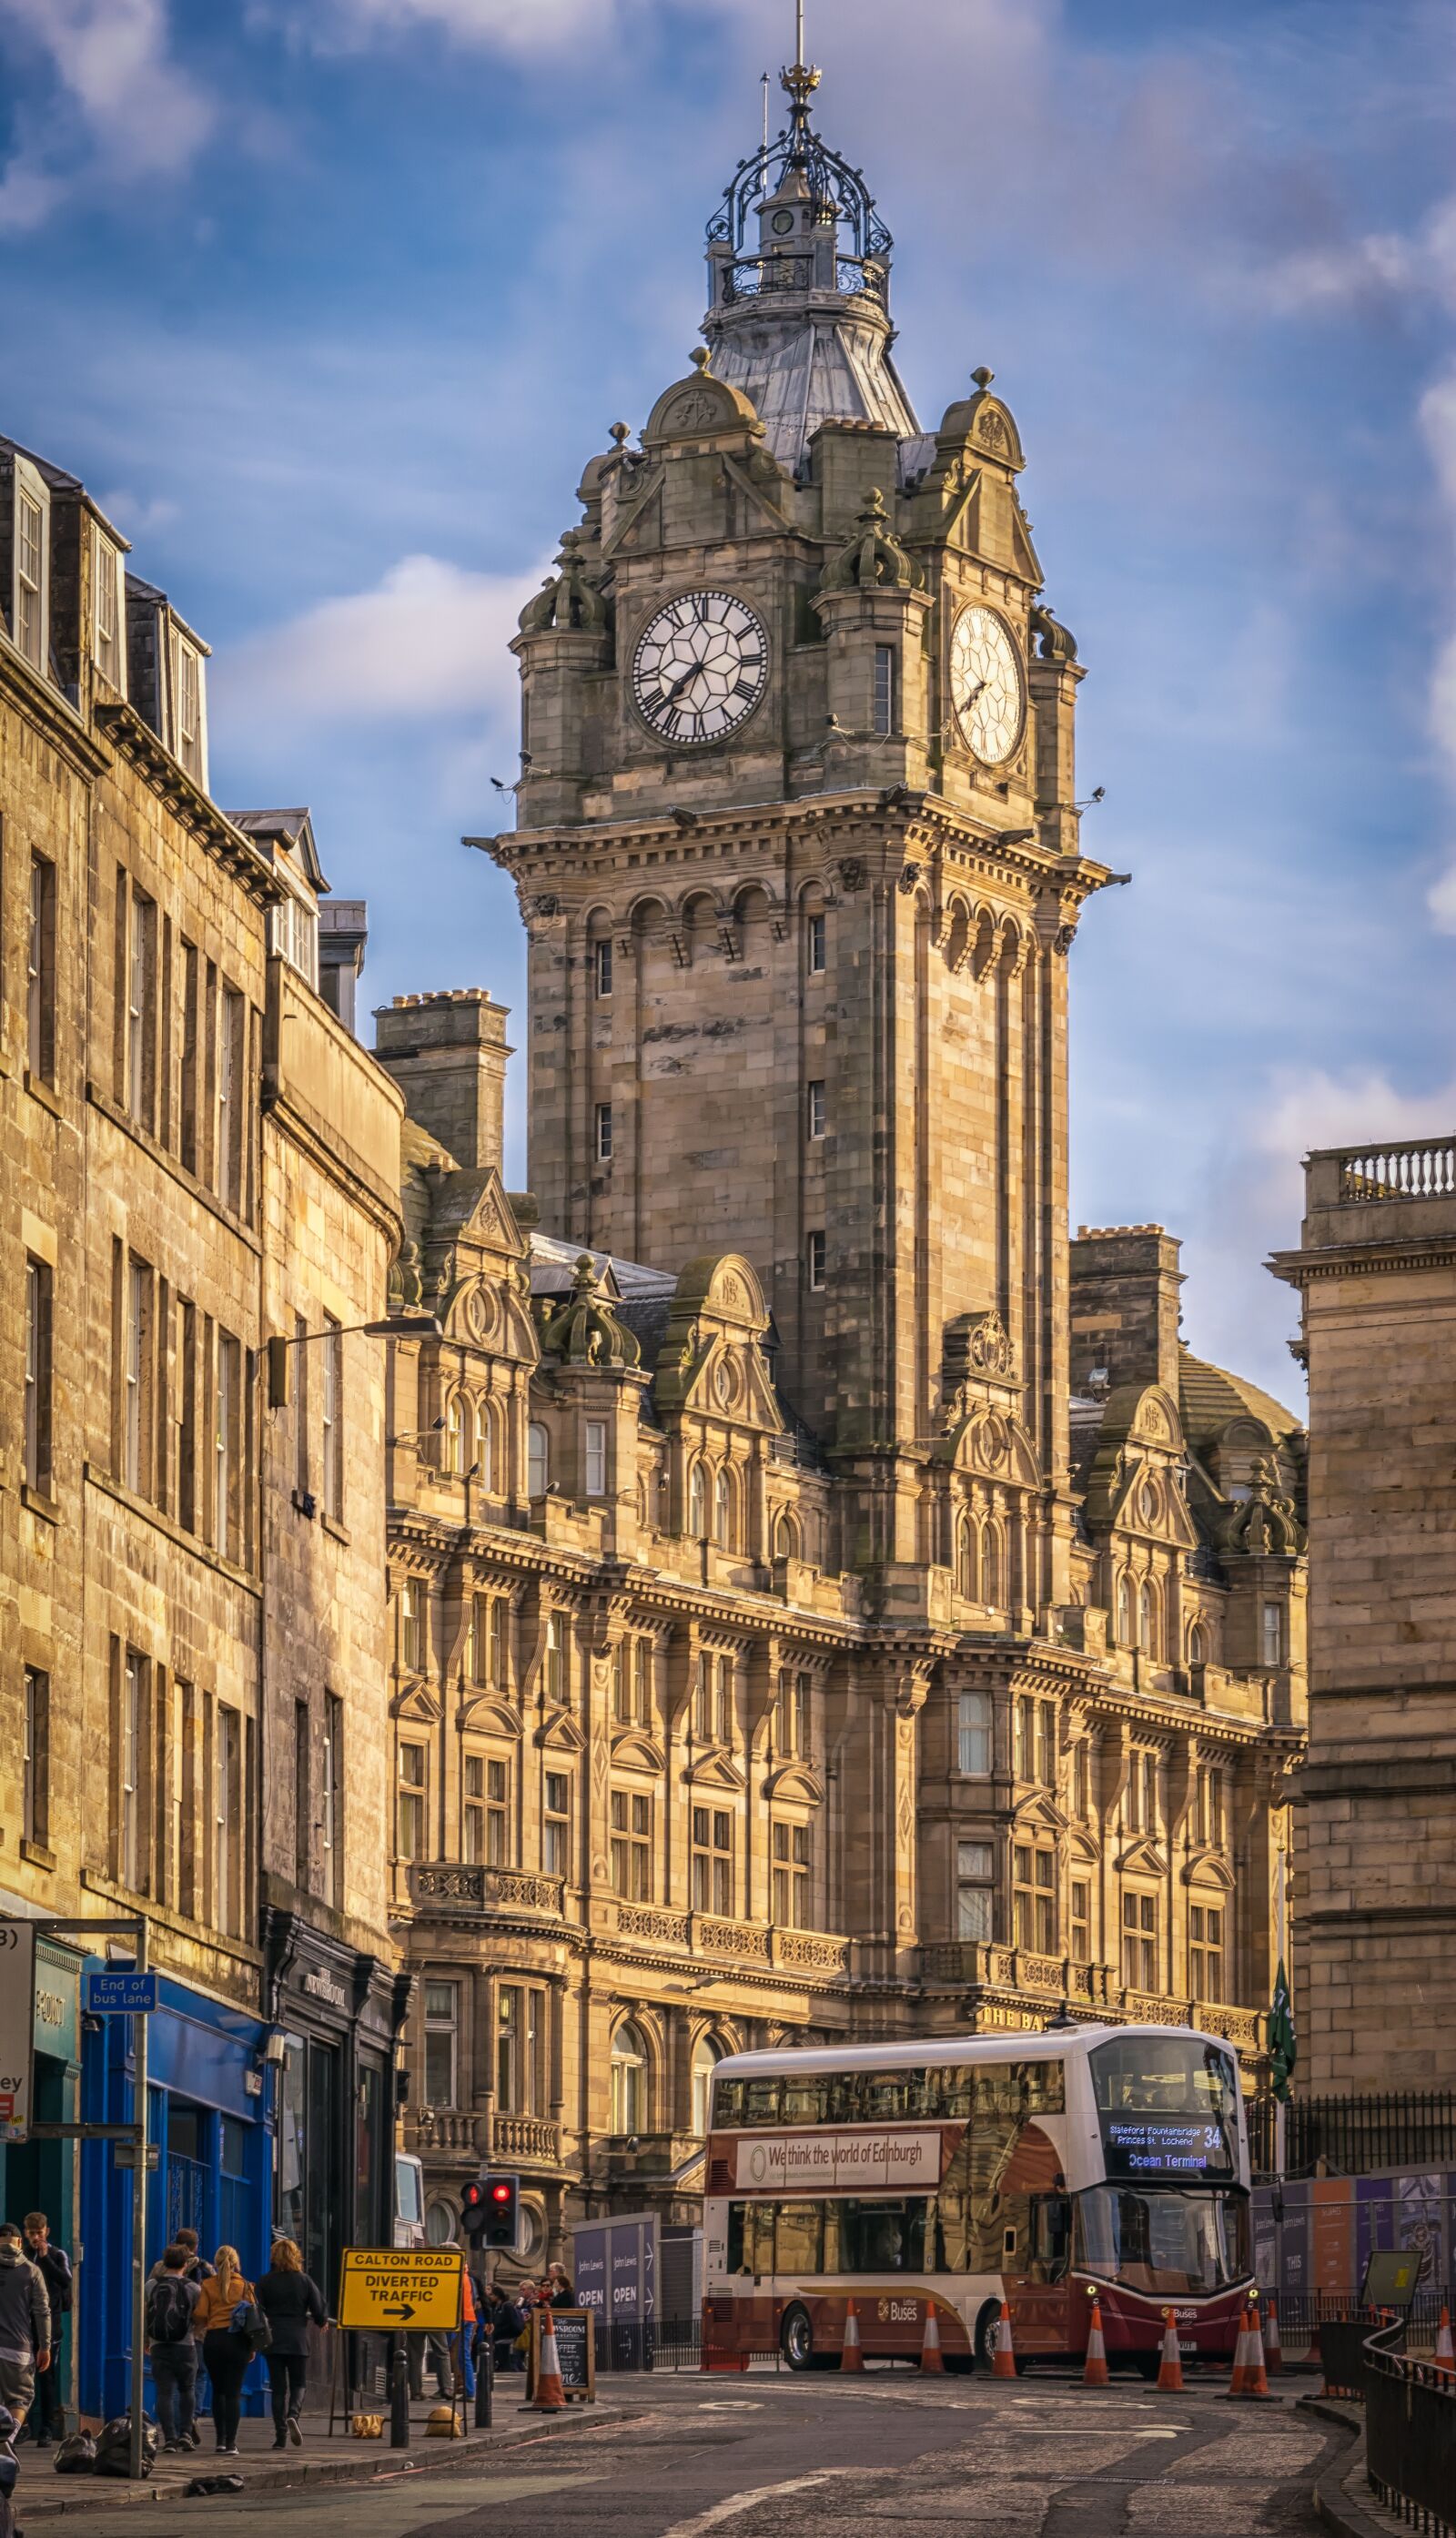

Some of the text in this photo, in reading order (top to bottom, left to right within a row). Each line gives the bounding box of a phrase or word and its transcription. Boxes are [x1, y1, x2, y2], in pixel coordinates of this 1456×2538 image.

[100, 1978, 146, 1991] End of
[93, 1993, 152, 2005] bus lane
[983, 2007, 1016, 2027] THE
[1148, 2127, 1200, 2137] Fountainbridge
[1203, 2126, 1221, 2149] 34
[1117, 2136, 1146, 2145] Princes
[1161, 2137, 1194, 2146] Lochend
[769, 2140, 923, 2167] We think the world of Edinburgh
[1128, 2153, 1207, 2168] Ocean Terminal
[354, 2254, 453, 2267] CALTON ROAD
[365, 2275, 440, 2288] DIVERTED
[369, 2290, 433, 2302] TRAFFIC
[578, 2289, 604, 2307] OPEN
[612, 2285, 637, 2303] OPEN
[890, 2301, 918, 2321] Buses
[1173, 2308, 1198, 2319] Buses
